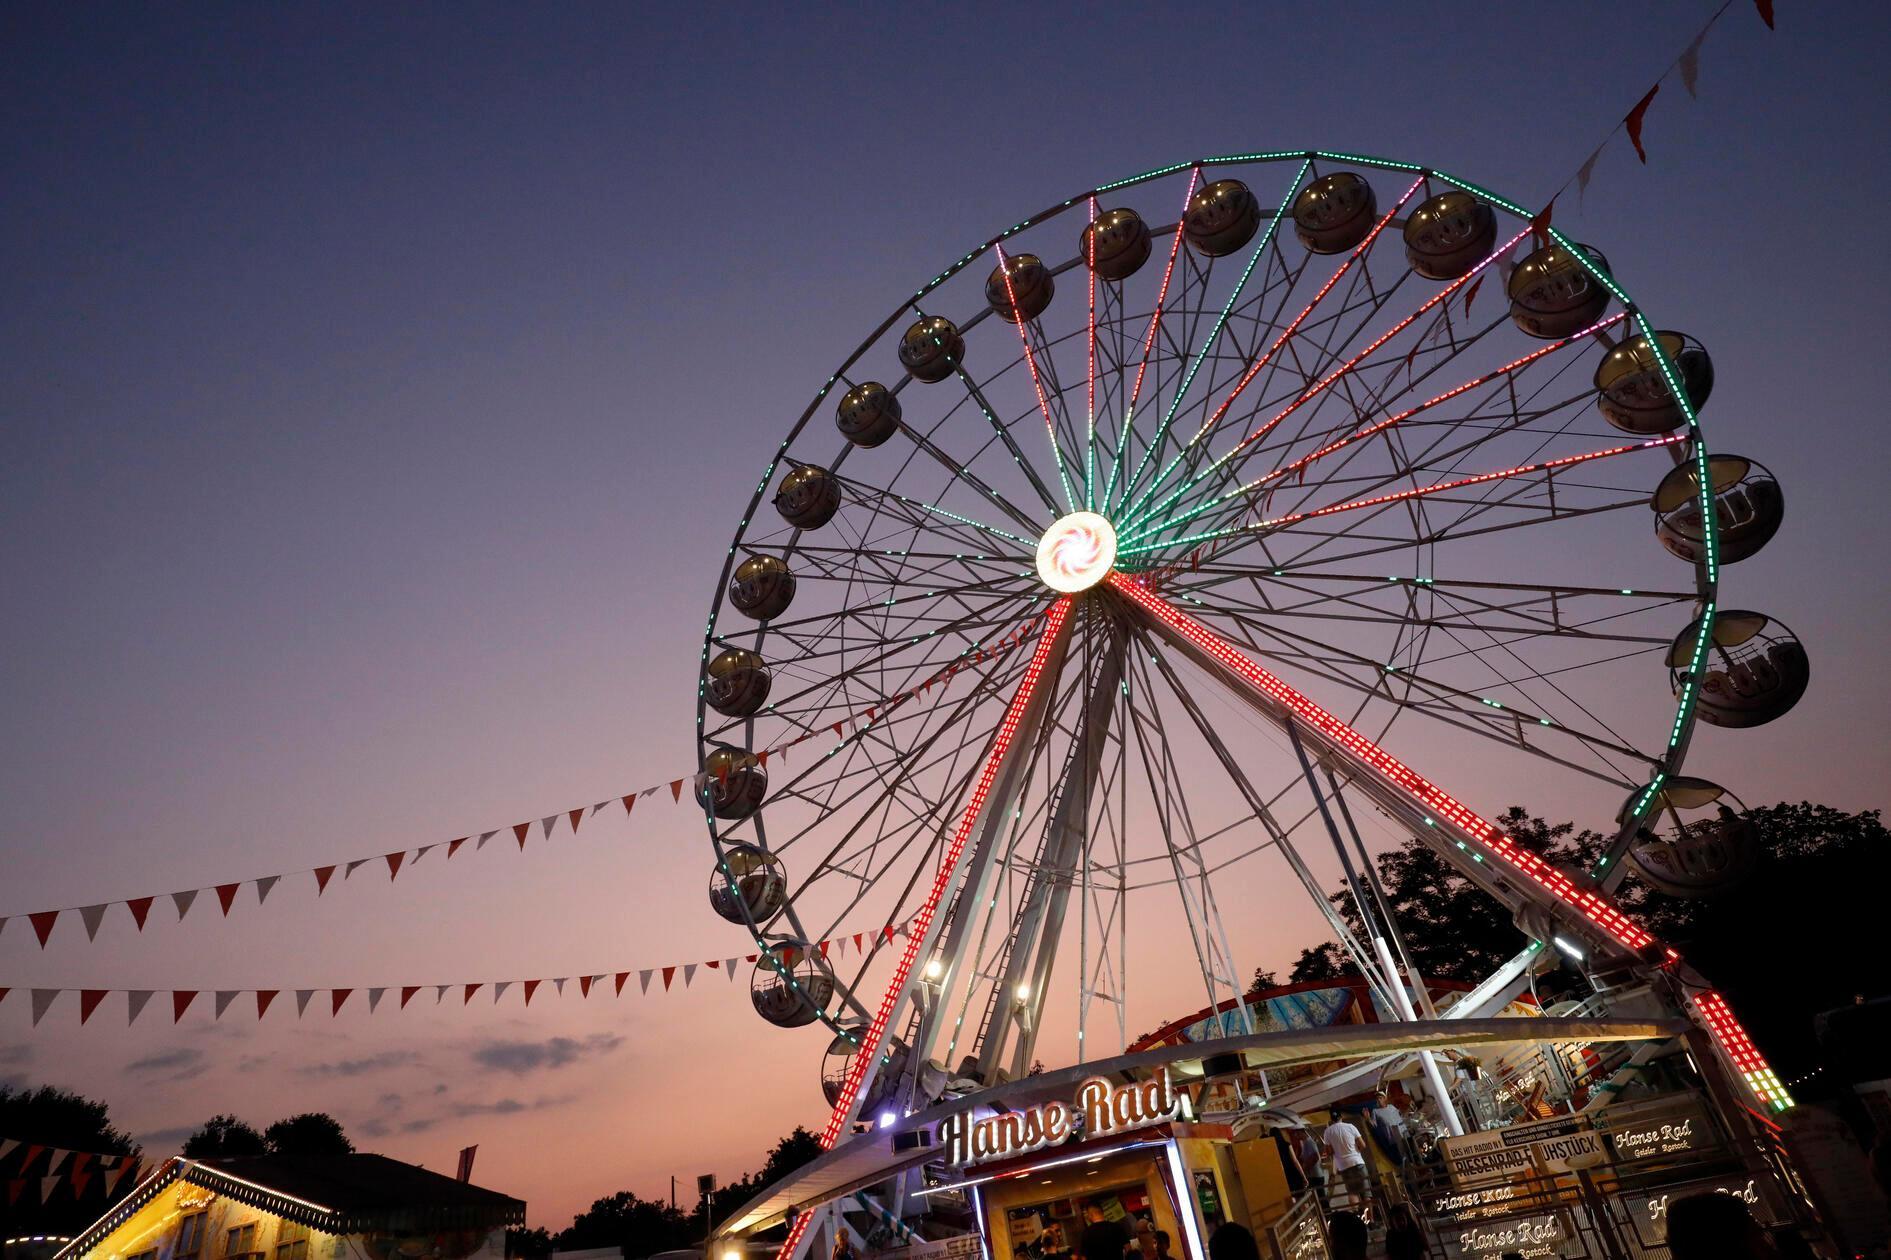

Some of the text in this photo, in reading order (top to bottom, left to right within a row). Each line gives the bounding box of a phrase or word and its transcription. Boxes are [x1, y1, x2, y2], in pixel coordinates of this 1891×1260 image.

[936, 1065, 1179, 1165] Hanse Rad
[1615, 1119, 1692, 1149] Hanse Rad
[1450, 1147, 1464, 1157] DAS
[1463, 1145, 1474, 1155] HIT
[1474, 1142, 1494, 1153] RADIO
[1455, 1135, 1600, 1177] RIESENRAD FÜHSTÜCK
[1634, 1140, 1692, 1158] Geisler Rostock
[1482, 1203, 1513, 1217] Rostock
[1459, 1214, 1557, 1252] Hanse Rad
[1518, 1243, 1556, 1260] Rostock
